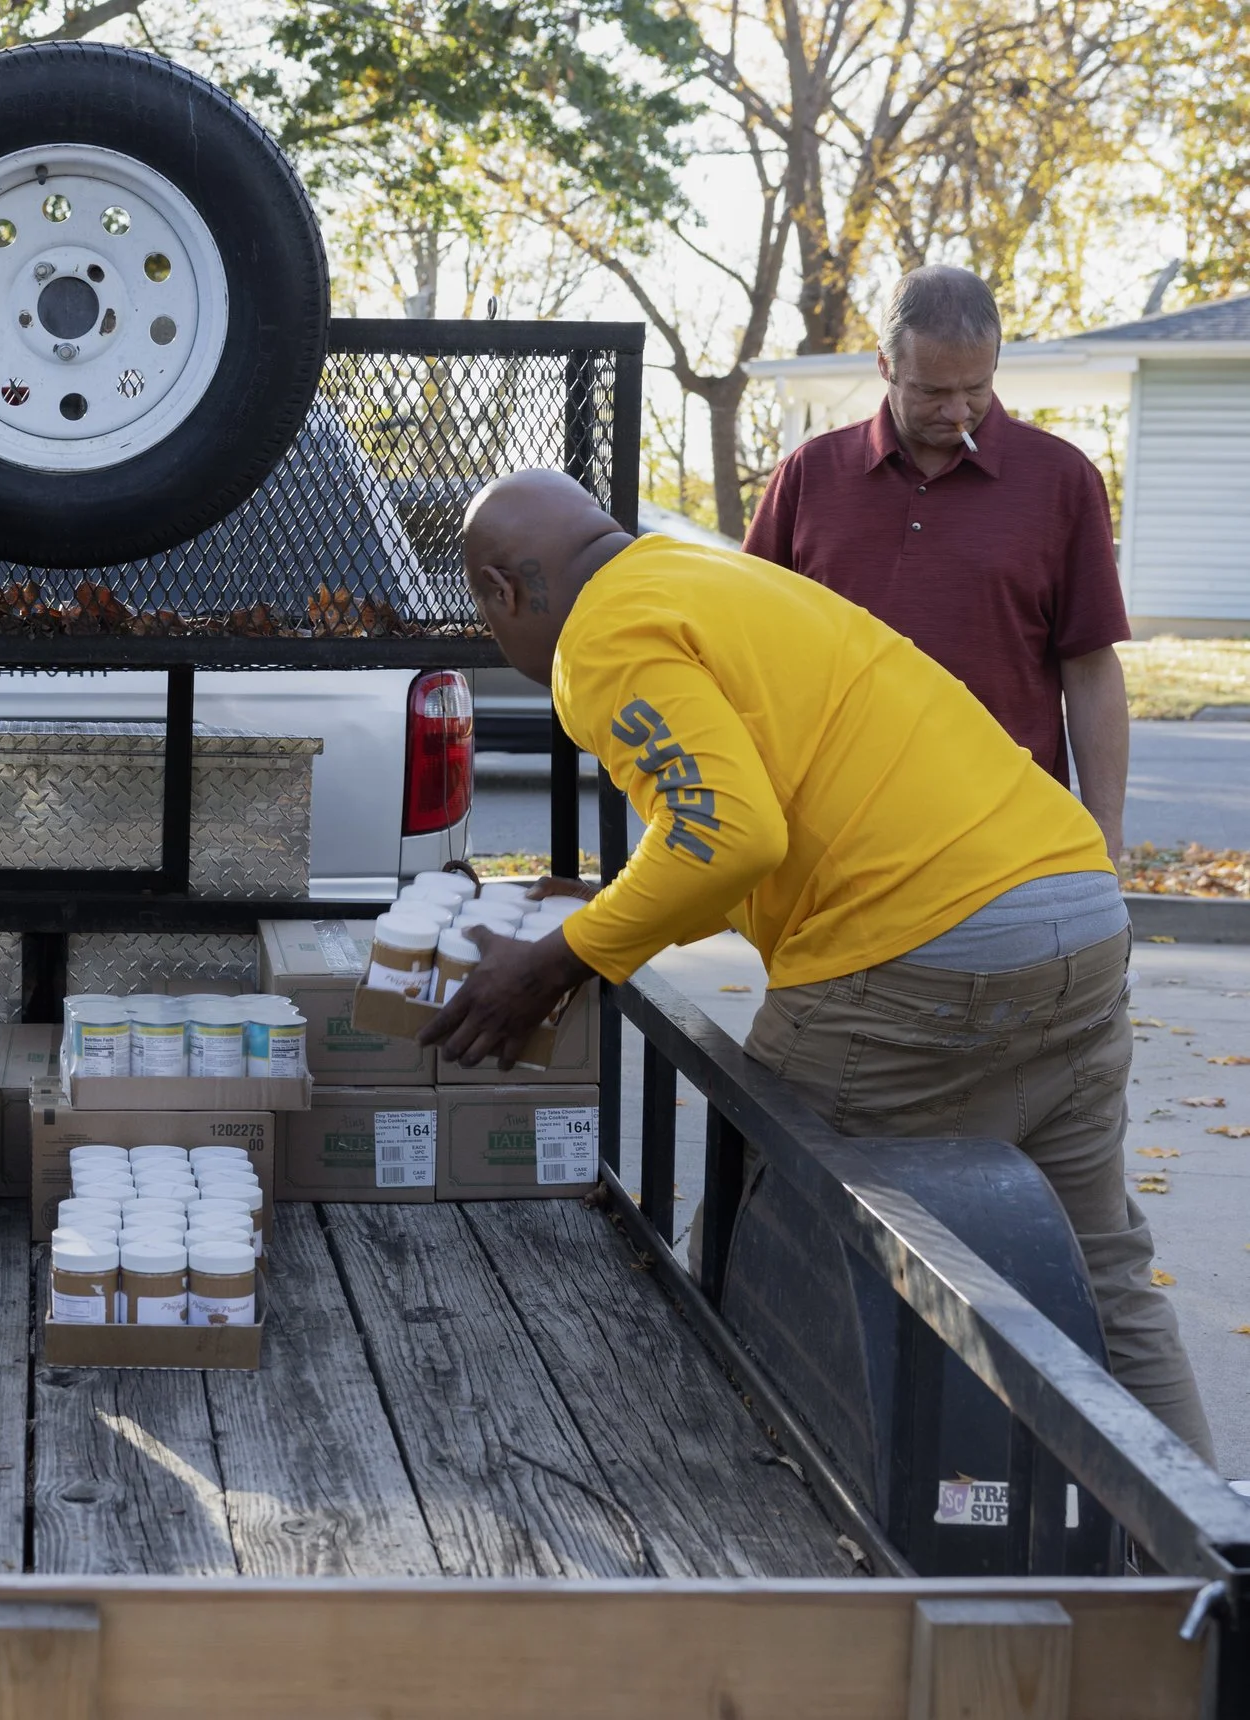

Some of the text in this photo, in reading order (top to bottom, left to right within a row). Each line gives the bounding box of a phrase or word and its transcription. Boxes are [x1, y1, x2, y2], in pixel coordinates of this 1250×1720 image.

[210, 1124, 264, 1136] 1202275
[405, 1124, 430, 1137] 164
[566, 1121, 591, 1134] 164
[249, 1138, 264, 1151] 00
